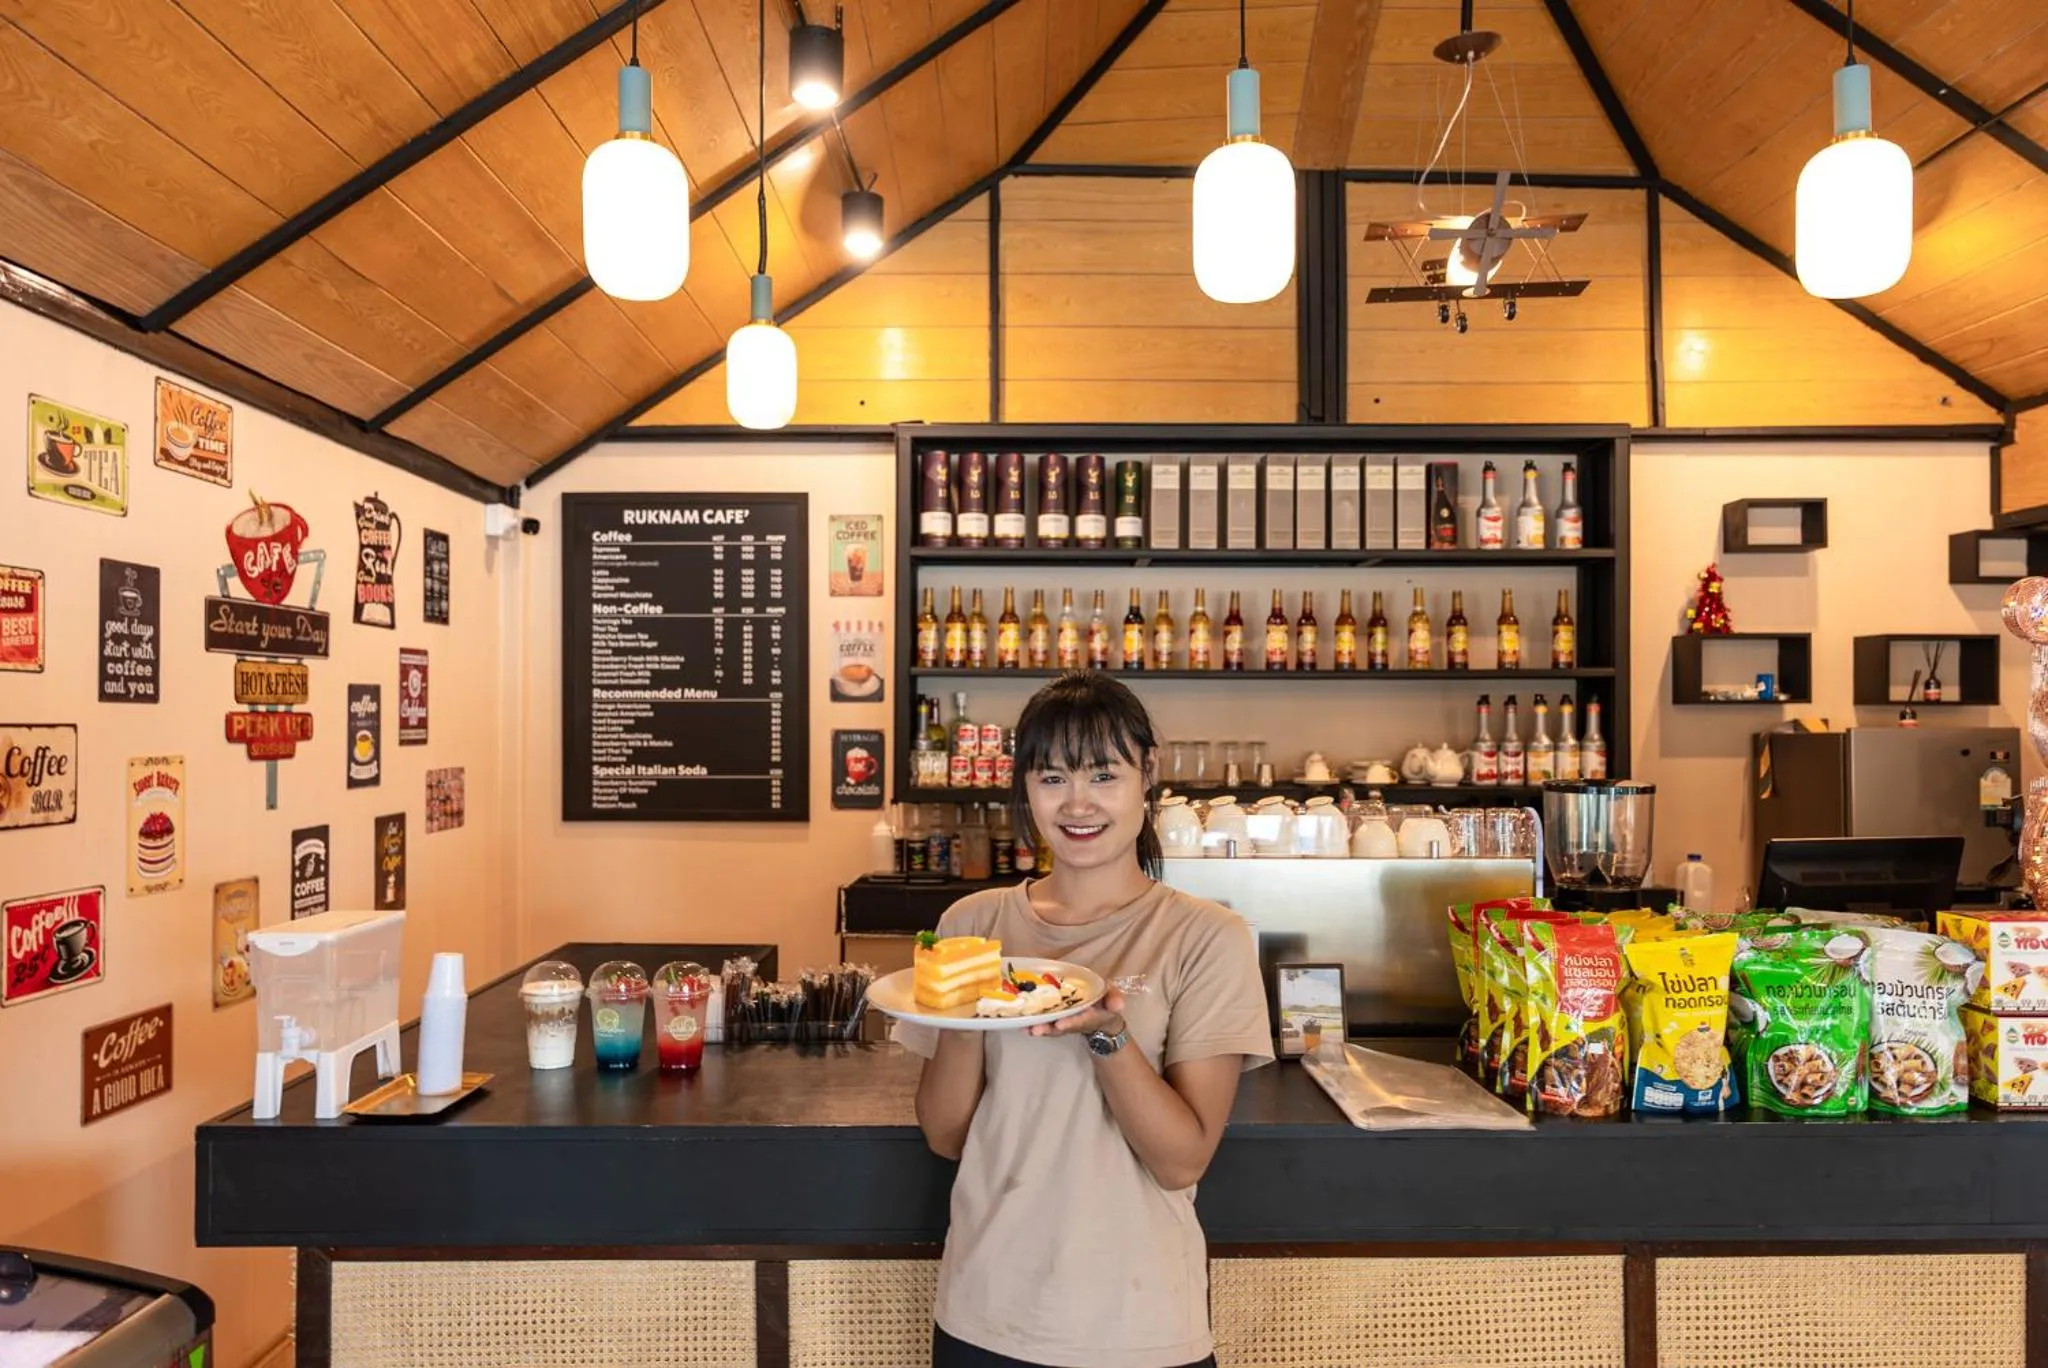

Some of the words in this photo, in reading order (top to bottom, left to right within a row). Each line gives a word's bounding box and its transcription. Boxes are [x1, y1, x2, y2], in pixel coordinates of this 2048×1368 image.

[190, 406, 228, 436] Coffee
[198, 438, 227, 455] TIME
[83, 450, 120, 495] TEA
[623, 509, 700, 525] RUKNAM
[844, 520, 868, 531] ICED
[360, 529, 392, 546] COFFEE
[592, 530, 633, 542] Coffee
[835, 530, 877, 541] COFFEE
[243, 541, 297, 578] CAFE
[357, 583, 394, 605] BOOKS
[592, 602, 664, 614] Non-Coffee
[2, 616, 33, 636] BEST
[104, 617, 129, 638] good
[209, 604, 260, 636] Start
[260, 619, 293, 648] your
[296, 614, 327, 652] Day
[103, 639, 130, 658] start
[131, 642, 157, 660] with
[106, 660, 153, 676] coffee
[104, 676, 126, 695] and
[127, 682, 155, 699] you
[592, 687, 682, 699] Recommended
[683, 687, 718, 699] Menu
[350, 694, 378, 719] coffee
[4, 745, 69, 788] Coffee
[592, 764, 636, 777] Special
[637, 764, 676, 777] Italian
[677, 764, 708, 777] Soda
[294, 876, 326, 898] COFFEE
[11, 904, 66, 960] Coffee
[1657, 971, 1718, 995] ไข่ปลา
[98, 1016, 160, 1069] Coffee
[92, 1087, 101, 1115] A
[104, 1074, 137, 1111] GOOD
[139, 1063, 165, 1097] IDEA
